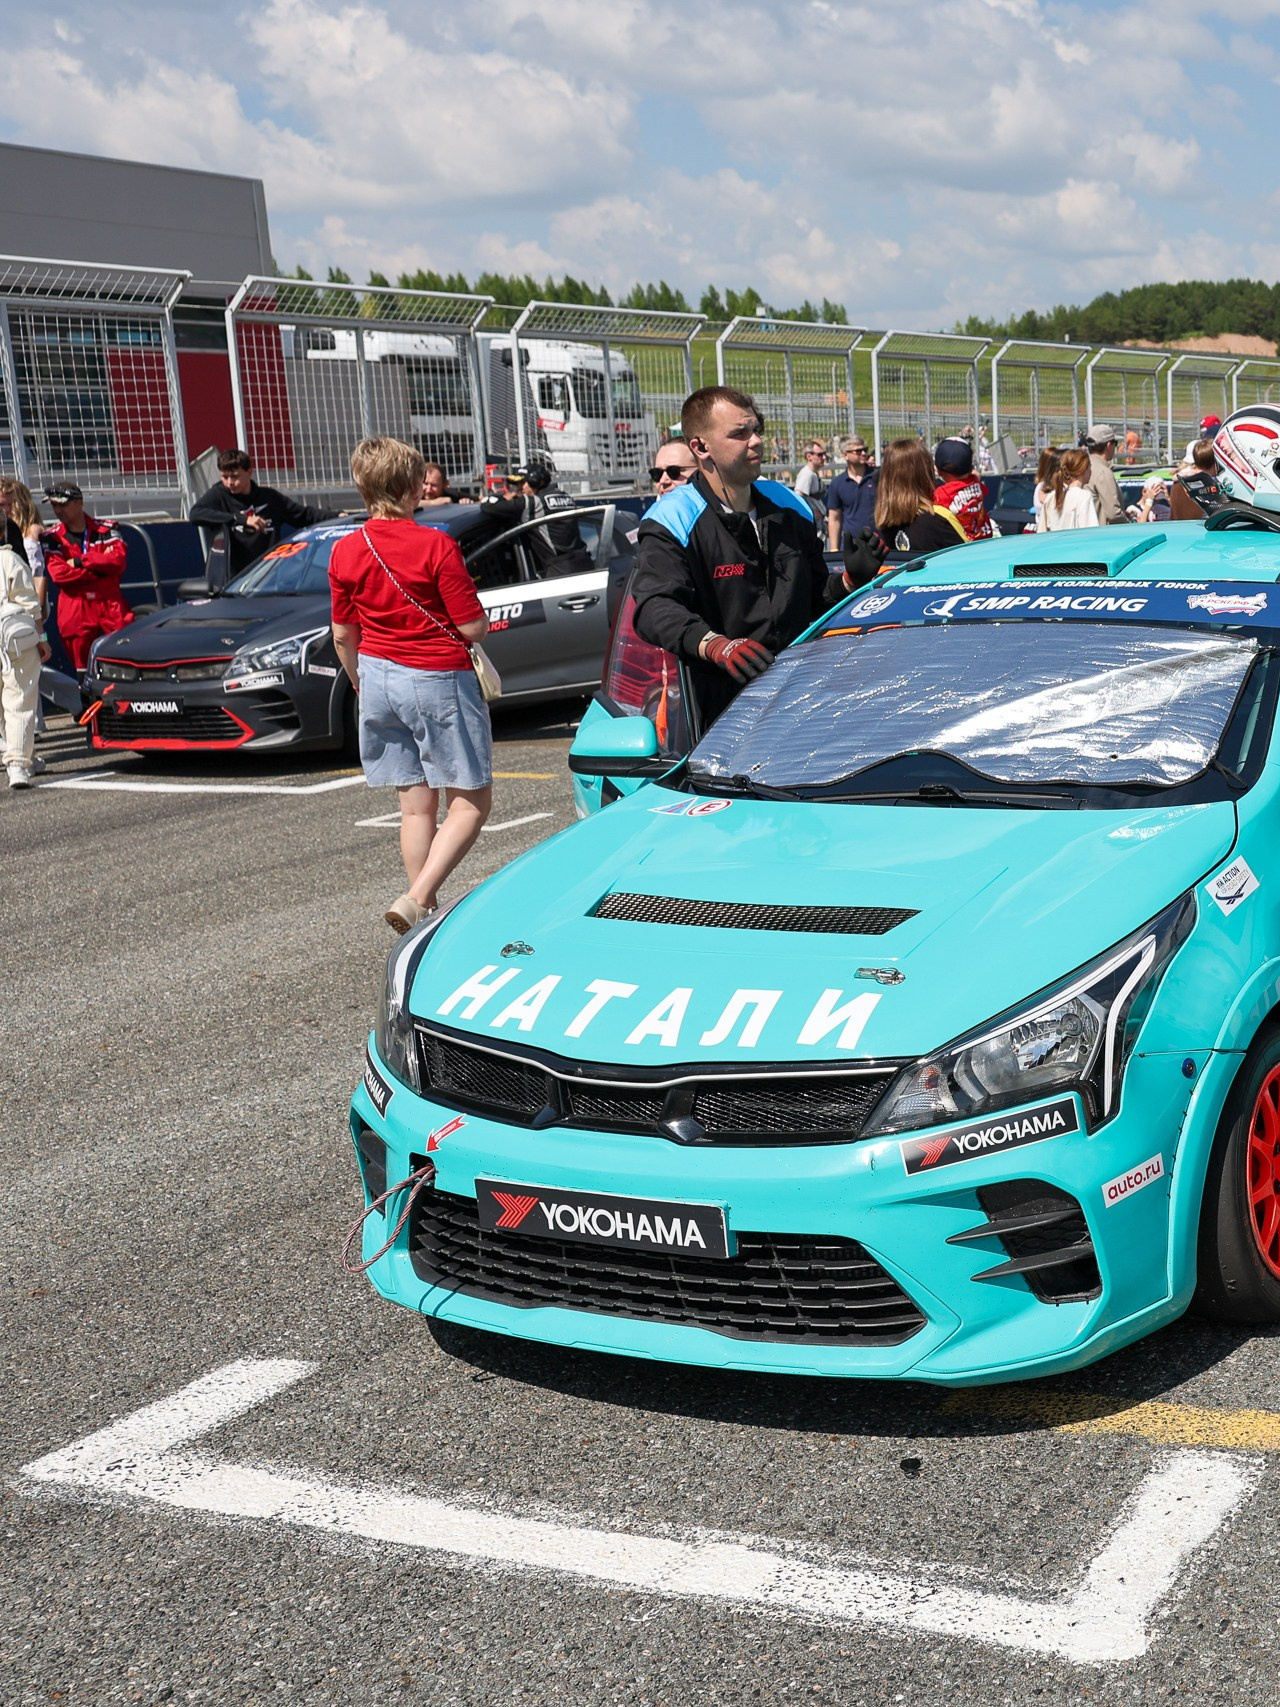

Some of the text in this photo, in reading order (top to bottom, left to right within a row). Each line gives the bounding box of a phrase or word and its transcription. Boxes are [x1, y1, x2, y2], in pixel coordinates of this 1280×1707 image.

[903, 581, 1209, 594] Российская серия кольцевых гонок
[961, 596, 1148, 612] SMP RACING
[240, 676, 279, 688] YOKOHAMA
[130, 701, 179, 713] YOKOHAMA
[698, 802, 722, 812] E
[1222, 865, 1240, 884] ACTION
[436, 964, 883, 1049] НАТАЛИ
[952, 1110, 1066, 1154] YOKOHAMA
[1108, 1160, 1161, 1200] auto.ru
[539, 1202, 706, 1249] YOKOHAMA
